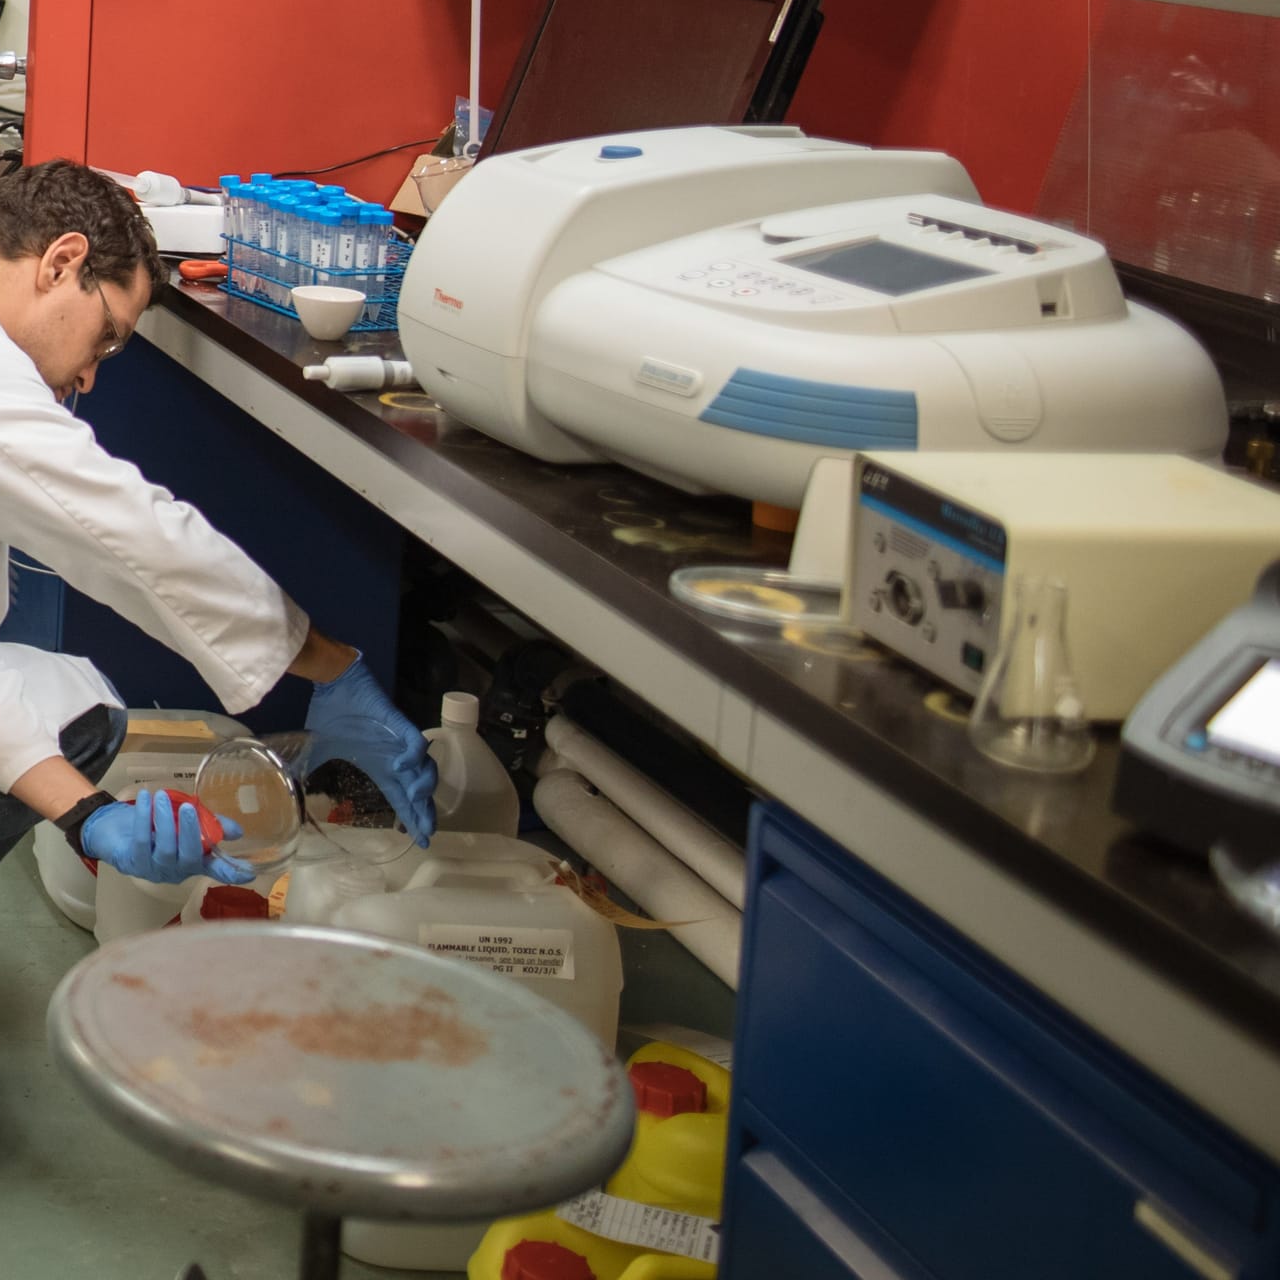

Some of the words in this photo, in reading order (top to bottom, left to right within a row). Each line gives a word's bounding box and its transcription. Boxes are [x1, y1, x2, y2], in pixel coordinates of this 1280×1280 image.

[479, 936, 490, 944] UN
[493, 936, 513, 944] 1992
[478, 945, 510, 955] LIQUID,
[512, 947, 537, 955] TOXIC
